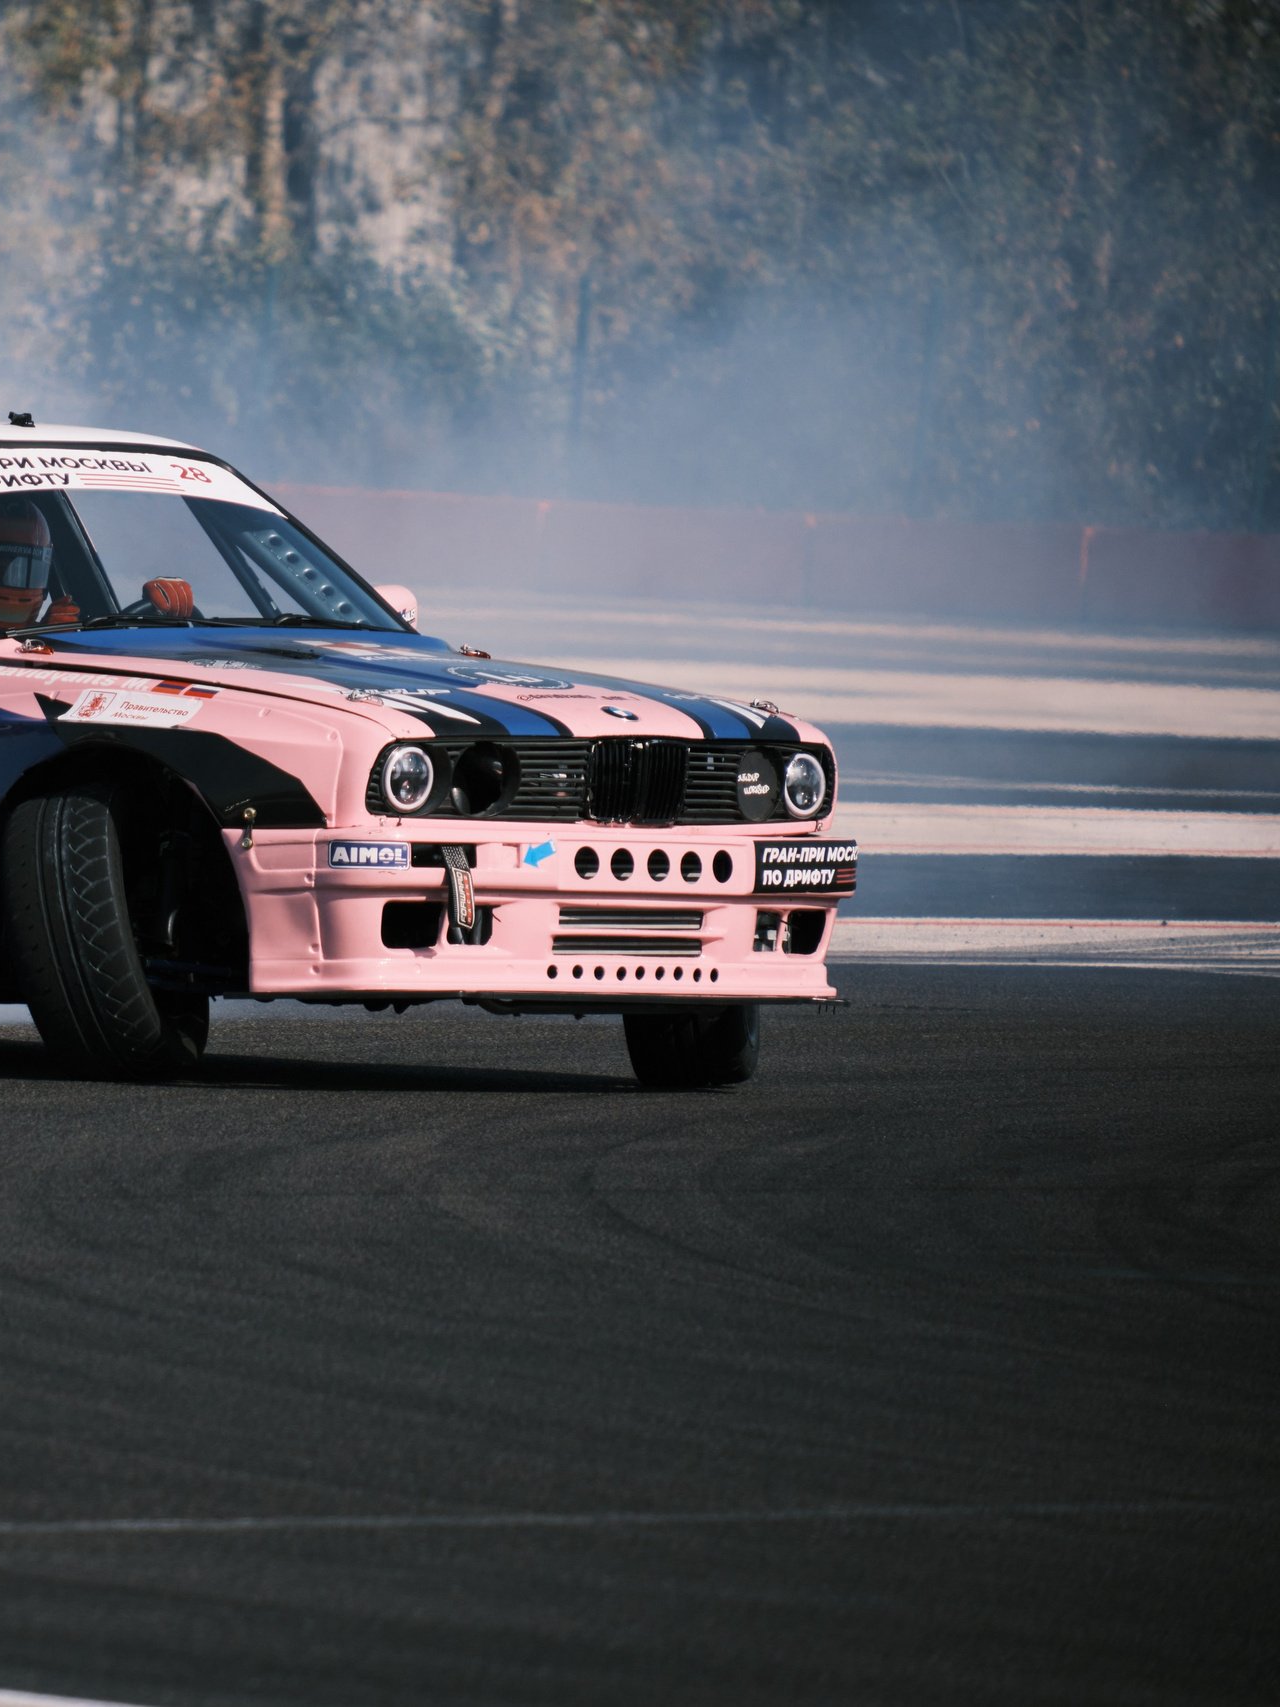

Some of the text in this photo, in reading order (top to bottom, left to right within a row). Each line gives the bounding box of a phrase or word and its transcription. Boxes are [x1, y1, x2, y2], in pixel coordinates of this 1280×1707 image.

[37, 457, 152, 473] МОСКВЫ
[169, 464, 212, 483] 28
[111, 712, 149, 721] Москвы
[120, 701, 189, 716] Правительство
[332, 846, 407, 864] AIMOL
[762, 847, 825, 863] ГРАН-ПРИ
[762, 869, 835, 887] ПО ДРИФТУ
[456, 871, 467, 923] FORWARD
